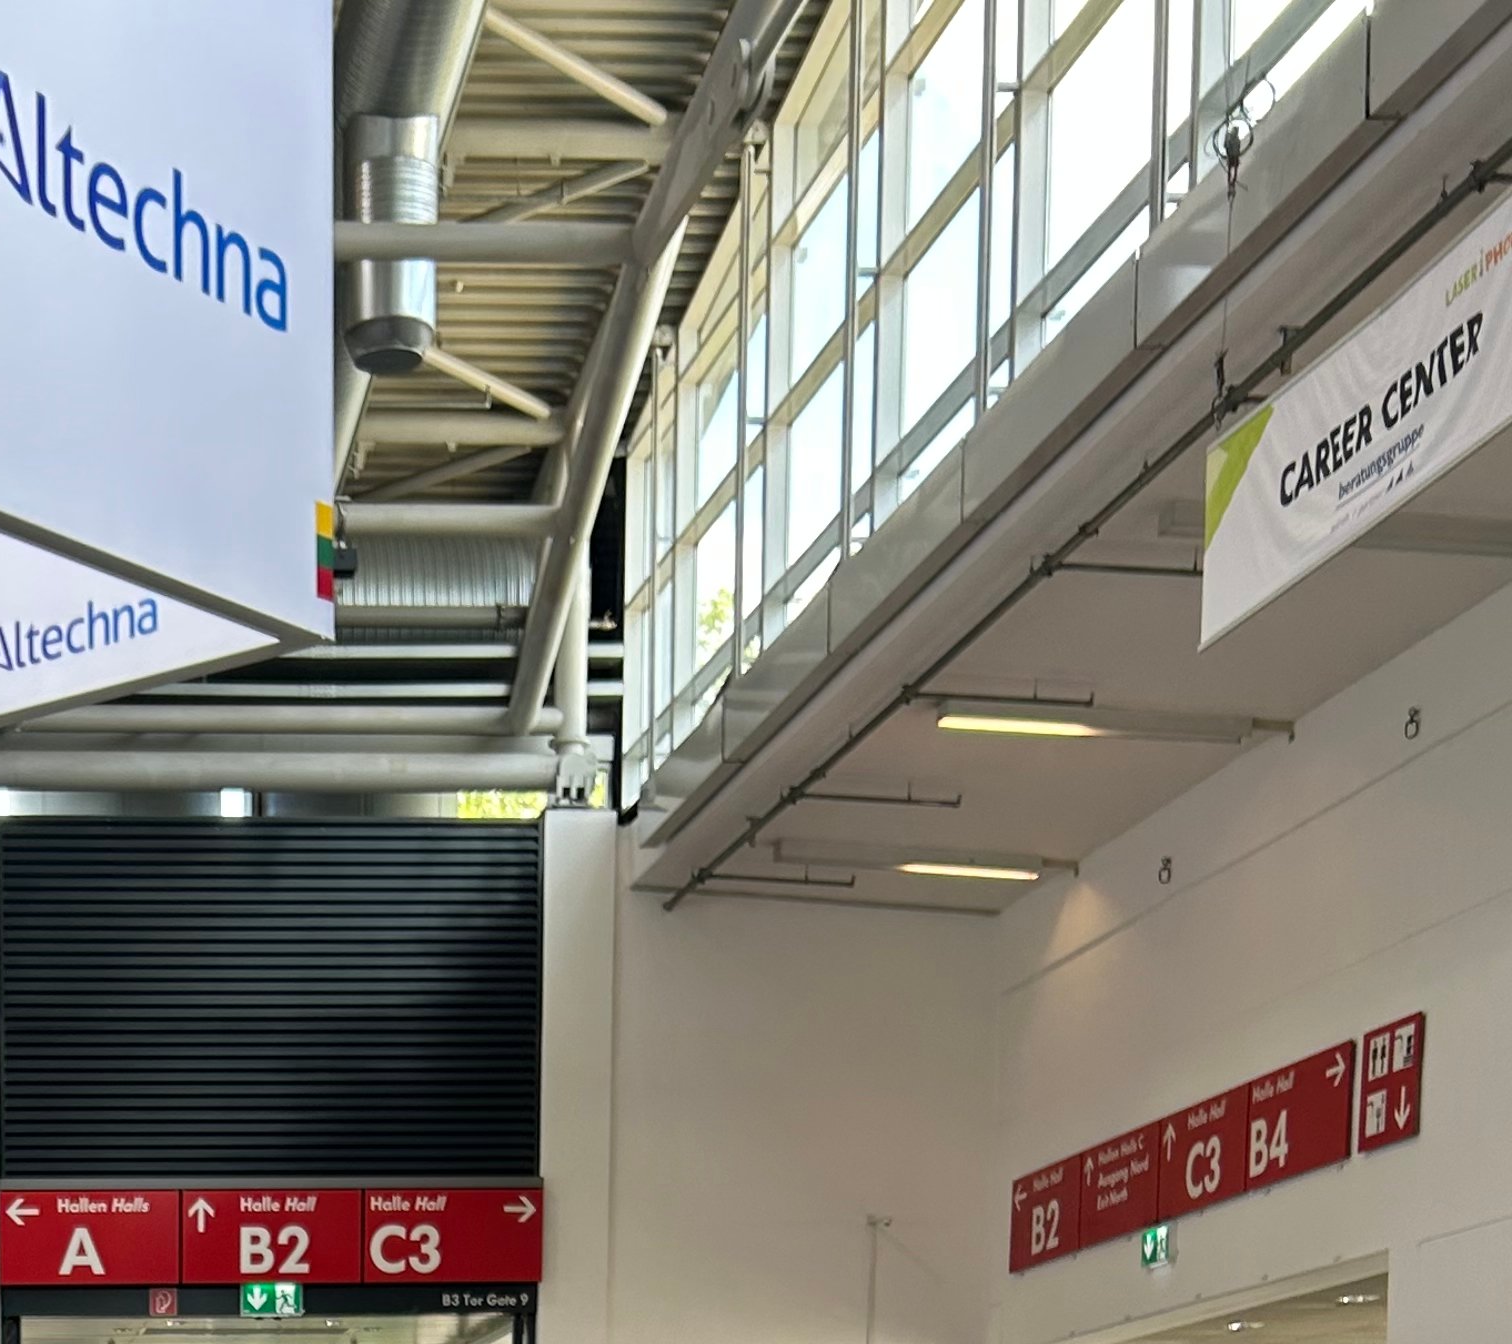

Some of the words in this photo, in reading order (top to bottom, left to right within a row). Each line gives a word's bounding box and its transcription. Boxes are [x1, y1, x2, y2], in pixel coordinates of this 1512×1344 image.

[1279, 403, 1373, 508] CAREER
[1381, 311, 1484, 431] CENTER
[1185, 1135, 1222, 1200] C3
[1249, 1109, 1289, 1179] B4
[56, 1197, 107, 1214] Hallen
[111, 1197, 151, 1214] Halls
[239, 1196, 280, 1213] Halle
[284, 1196, 318, 1213] Hall
[370, 1196, 411, 1212] Halle
[414, 1195, 448, 1212] Hall
[1031, 1199, 1060, 1257] B2
[58, 1225, 106, 1276] A
[239, 1225, 311, 1275] B2
[369, 1224, 442, 1275] C3
[442, 1294, 460, 1307] B3
[463, 1294, 484, 1307] Tor
[486, 1294, 516, 1307] Gate
[520, 1293, 529, 1307] 9
